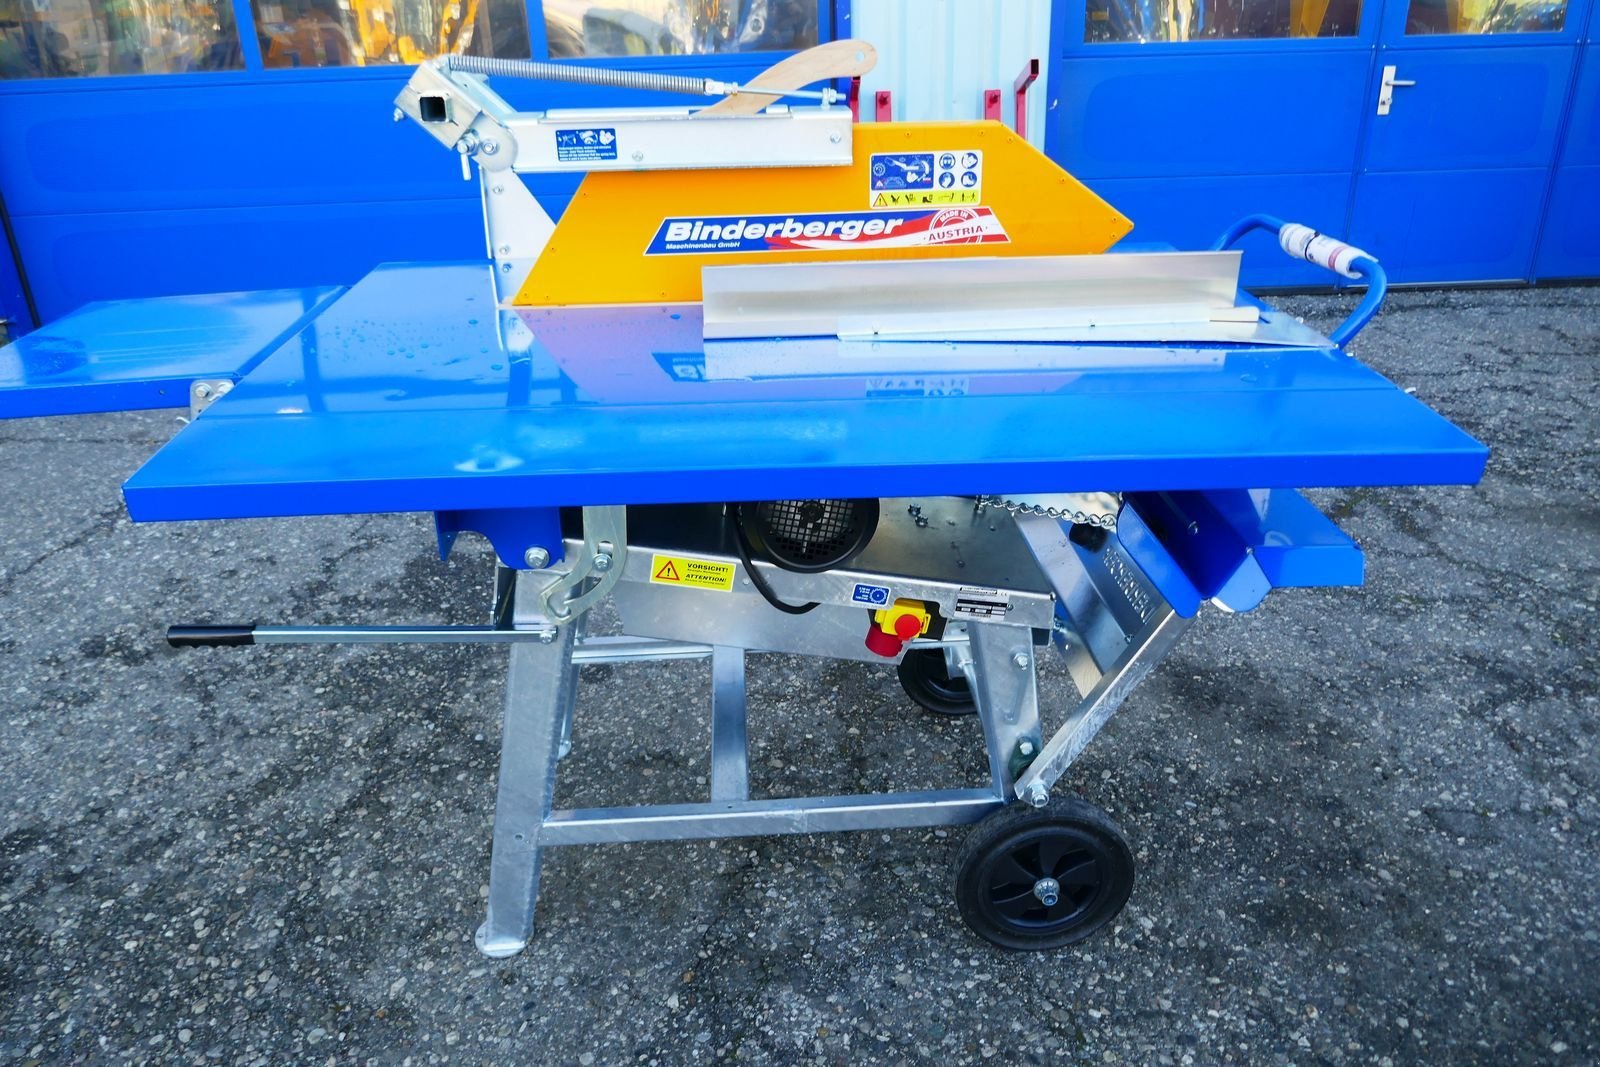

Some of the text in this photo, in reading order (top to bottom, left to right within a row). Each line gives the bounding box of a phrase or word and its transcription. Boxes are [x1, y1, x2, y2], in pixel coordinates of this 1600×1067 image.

[940, 210, 969, 222] MADE IN
[665, 218, 904, 241] Binderberger
[929, 225, 983, 241] AUSTRIA
[666, 241, 740, 250] Maschinenbau GmbH
[687, 563, 728, 573] VORSICHT!
[685, 573, 726, 582] ATTENTION!
